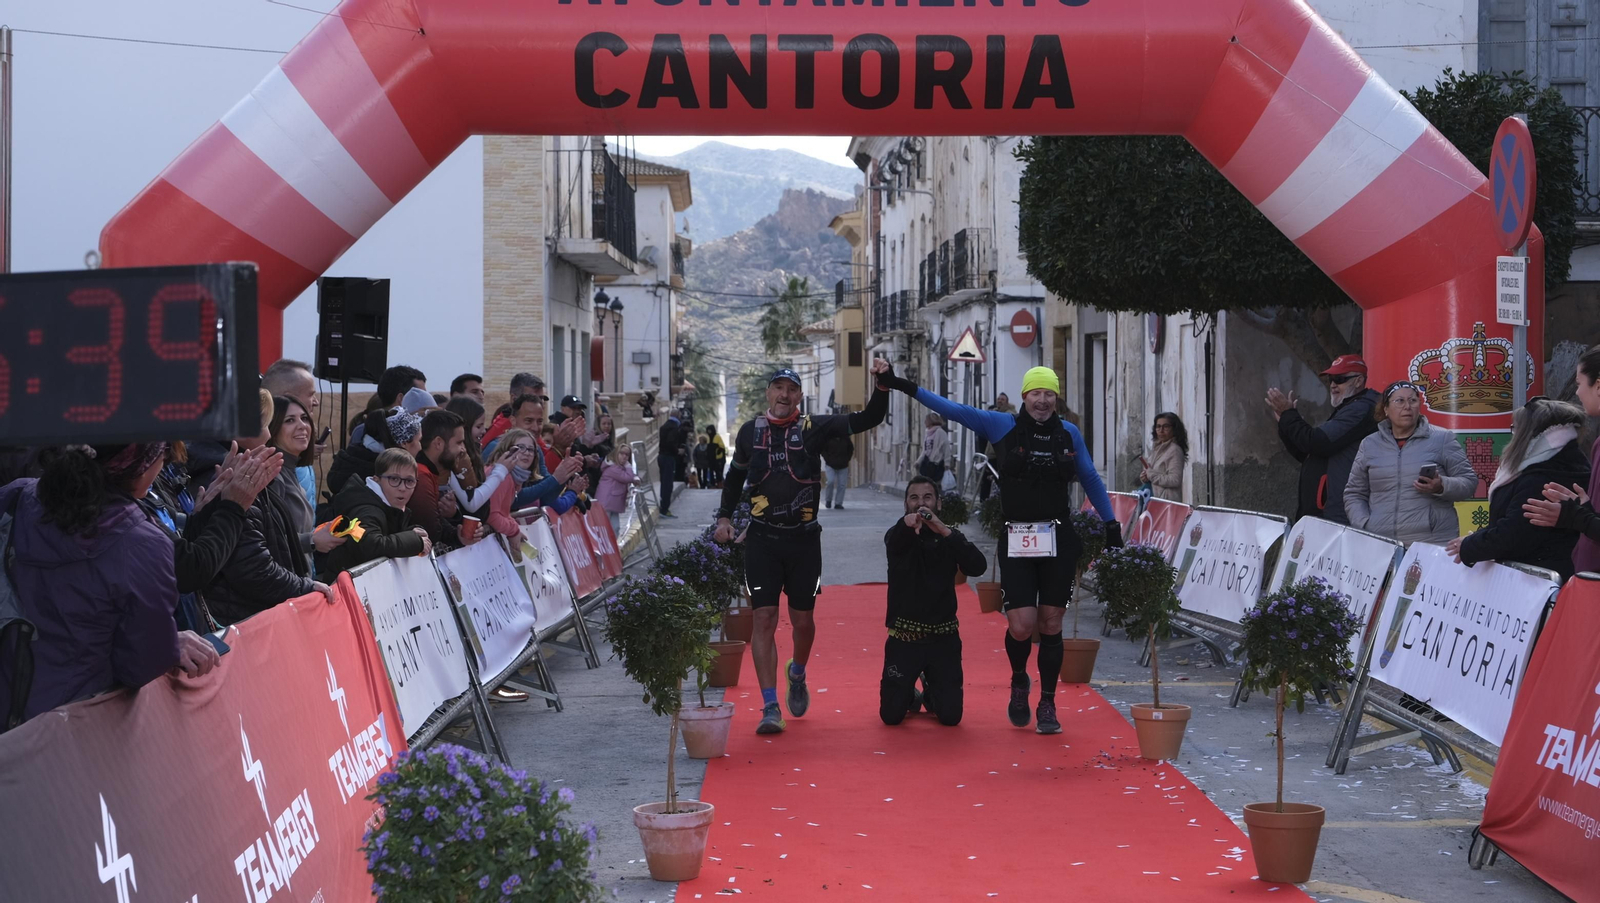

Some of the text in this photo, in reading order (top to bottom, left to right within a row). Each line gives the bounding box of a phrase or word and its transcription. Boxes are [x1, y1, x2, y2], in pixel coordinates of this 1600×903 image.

[574, 31, 1075, 109] CANTORIA
[0, 283, 217, 422] :39
[1022, 535, 1037, 548] 51
[1361, 574, 1378, 595] DE
[1419, 583, 1529, 643] AYUNTAMIENTO DE
[1402, 610, 1519, 700] CANTORIA
[328, 711, 394, 805] TEAMERGY
[234, 787, 320, 903] TEAMERGY
